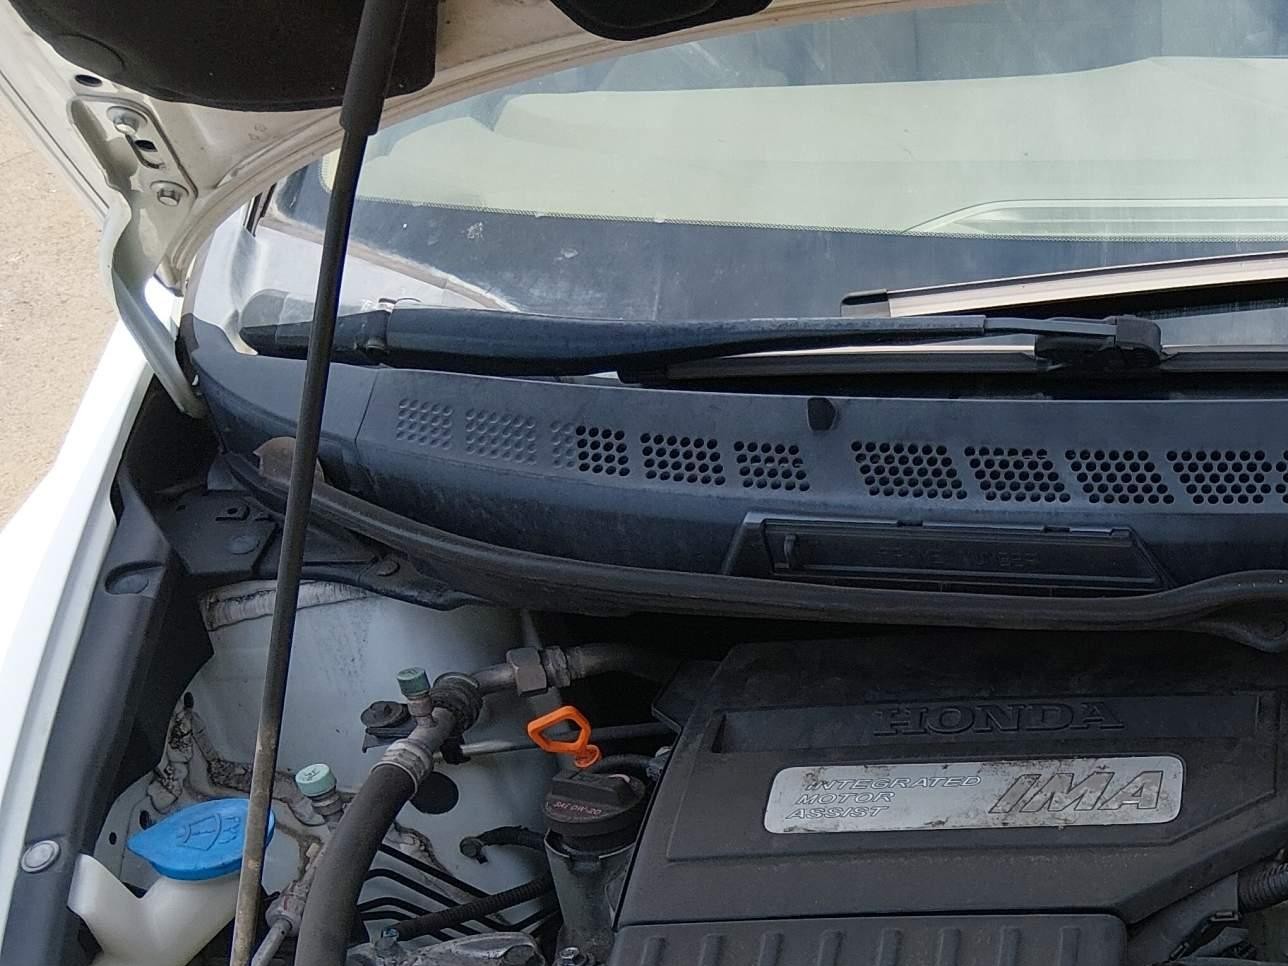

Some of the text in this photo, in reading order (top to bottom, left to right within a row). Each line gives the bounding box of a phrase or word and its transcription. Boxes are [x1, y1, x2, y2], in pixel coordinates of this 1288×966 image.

[873, 701, 1125, 736] HONDA
[805, 775, 982, 791] INTEGRATED
[795, 791, 896, 805] MOTOR
[988, 770, 1164, 814] IMA
[785, 805, 890, 820] ASSIST
